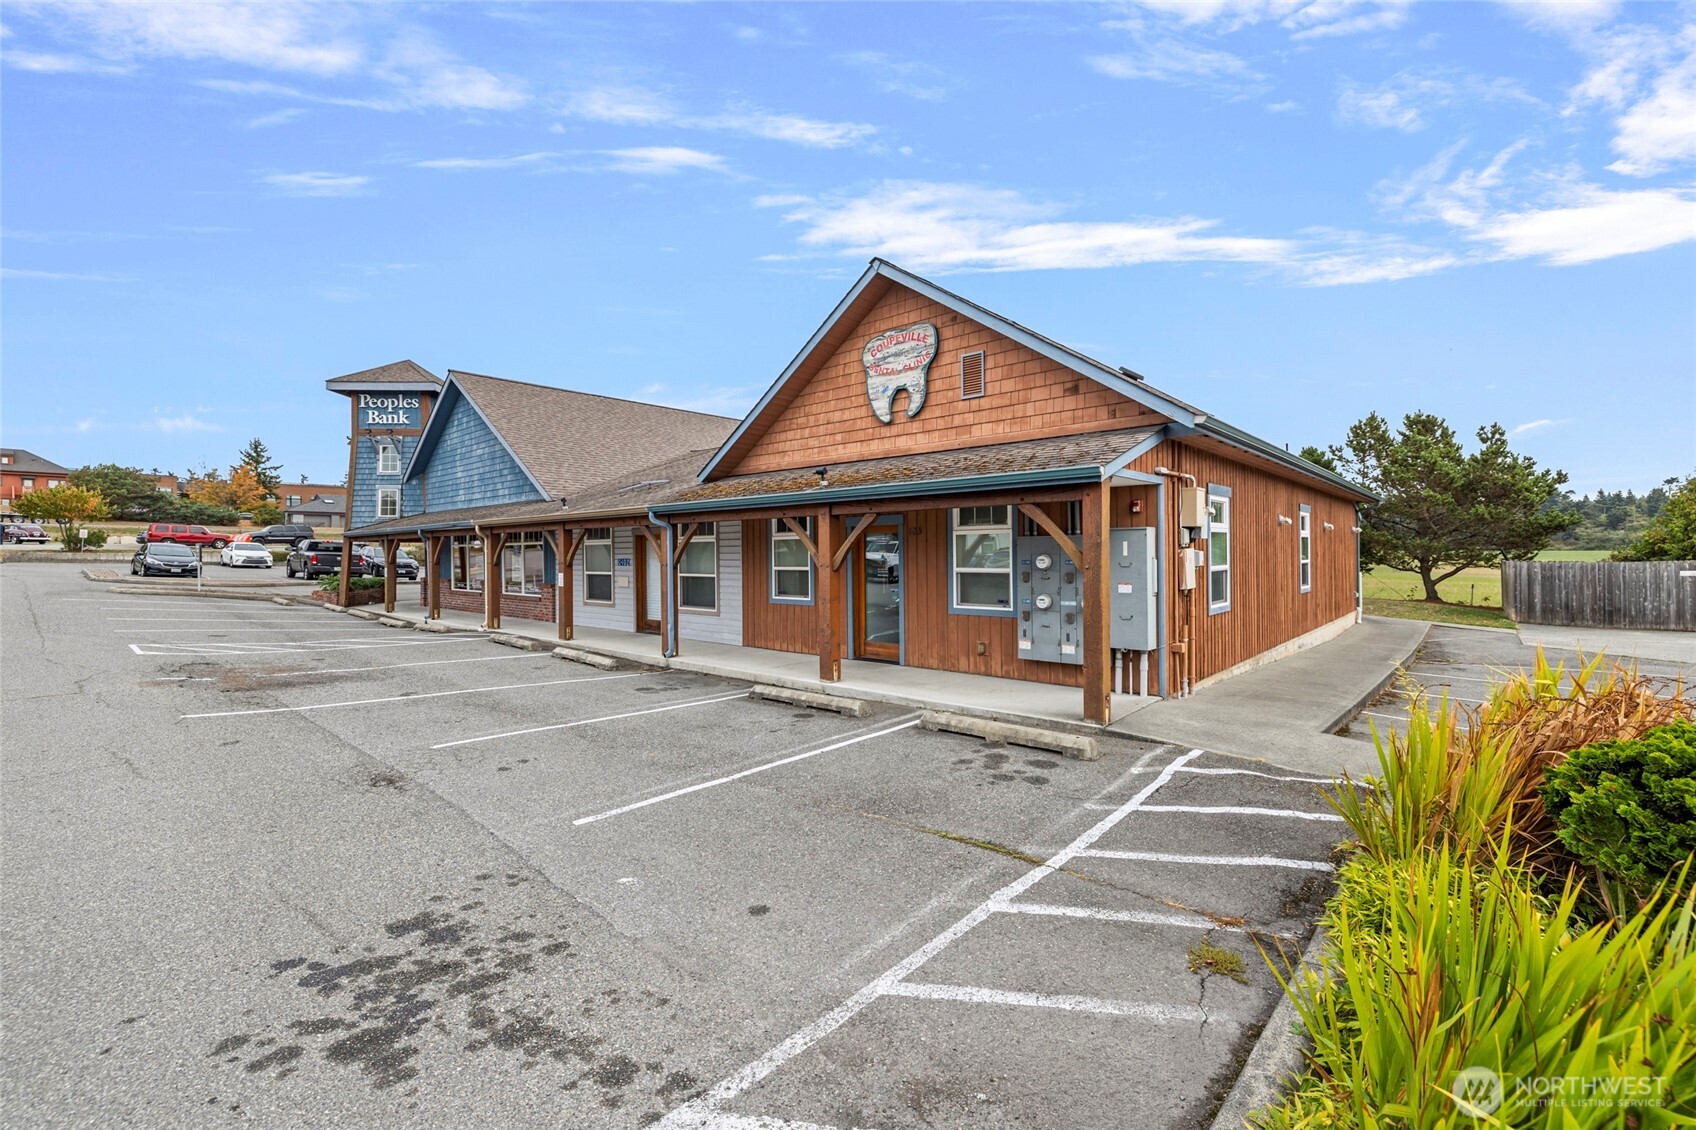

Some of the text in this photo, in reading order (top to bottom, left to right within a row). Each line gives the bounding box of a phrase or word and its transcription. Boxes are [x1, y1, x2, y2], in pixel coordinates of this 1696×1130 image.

[870, 332, 930, 358] COUPEVILLE
[902, 350, 932, 373] CLINIC
[358, 393, 420, 412] Peoples
[366, 409, 411, 424] Bank
